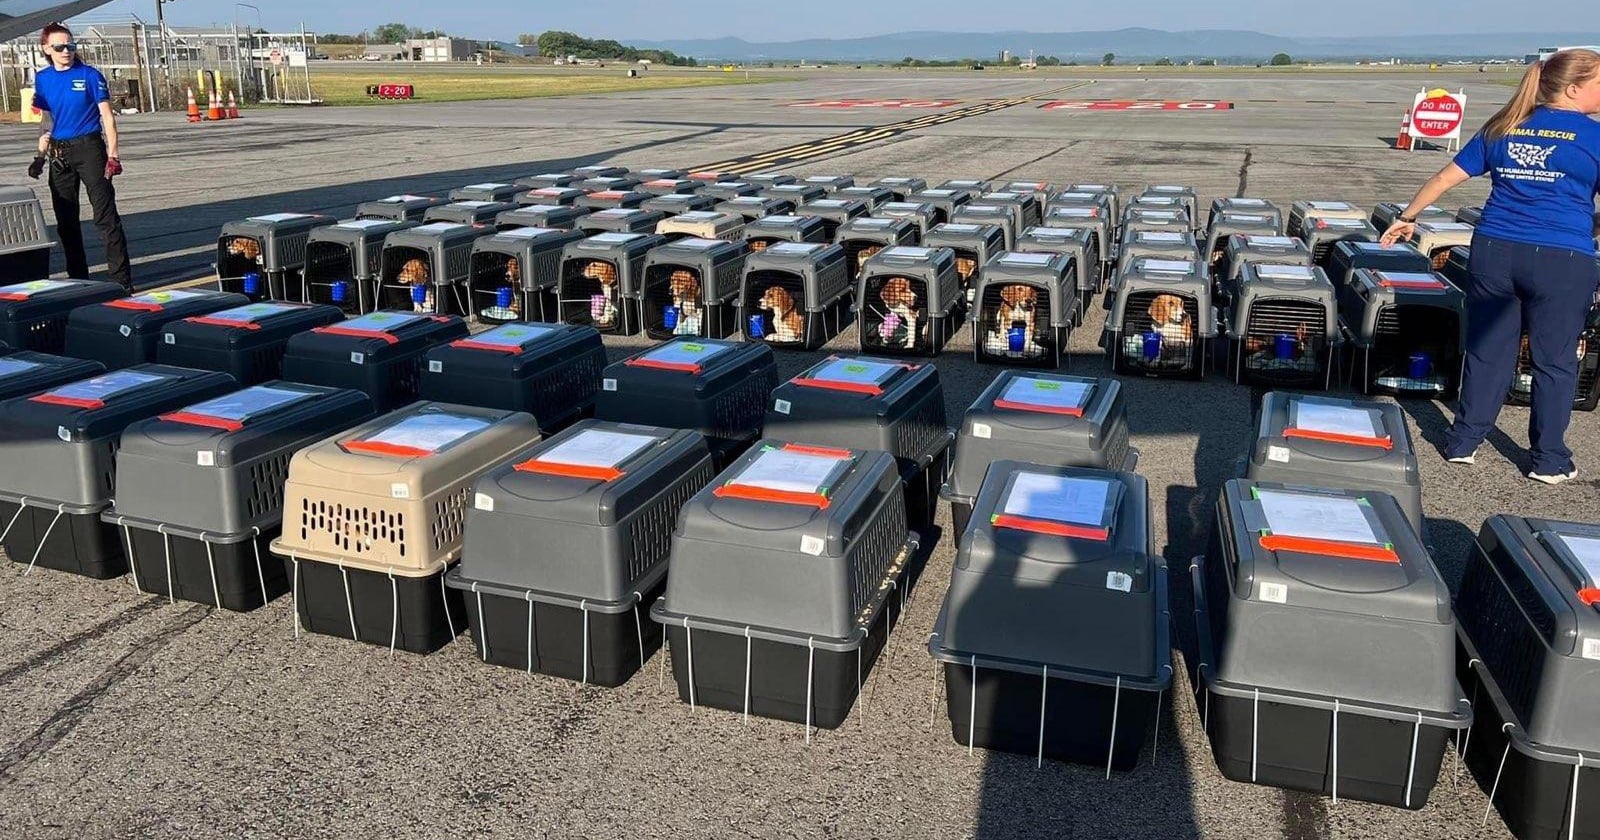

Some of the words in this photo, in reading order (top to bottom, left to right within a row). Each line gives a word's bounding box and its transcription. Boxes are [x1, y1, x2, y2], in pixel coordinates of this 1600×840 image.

[1438, 102, 1457, 111] NOT
[1421, 121, 1449, 129] ENTER
[1537, 129, 1577, 141] RESCUE
[1504, 167, 1534, 176] HUMANE
[1534, 169, 1566, 178] SOCIETY
